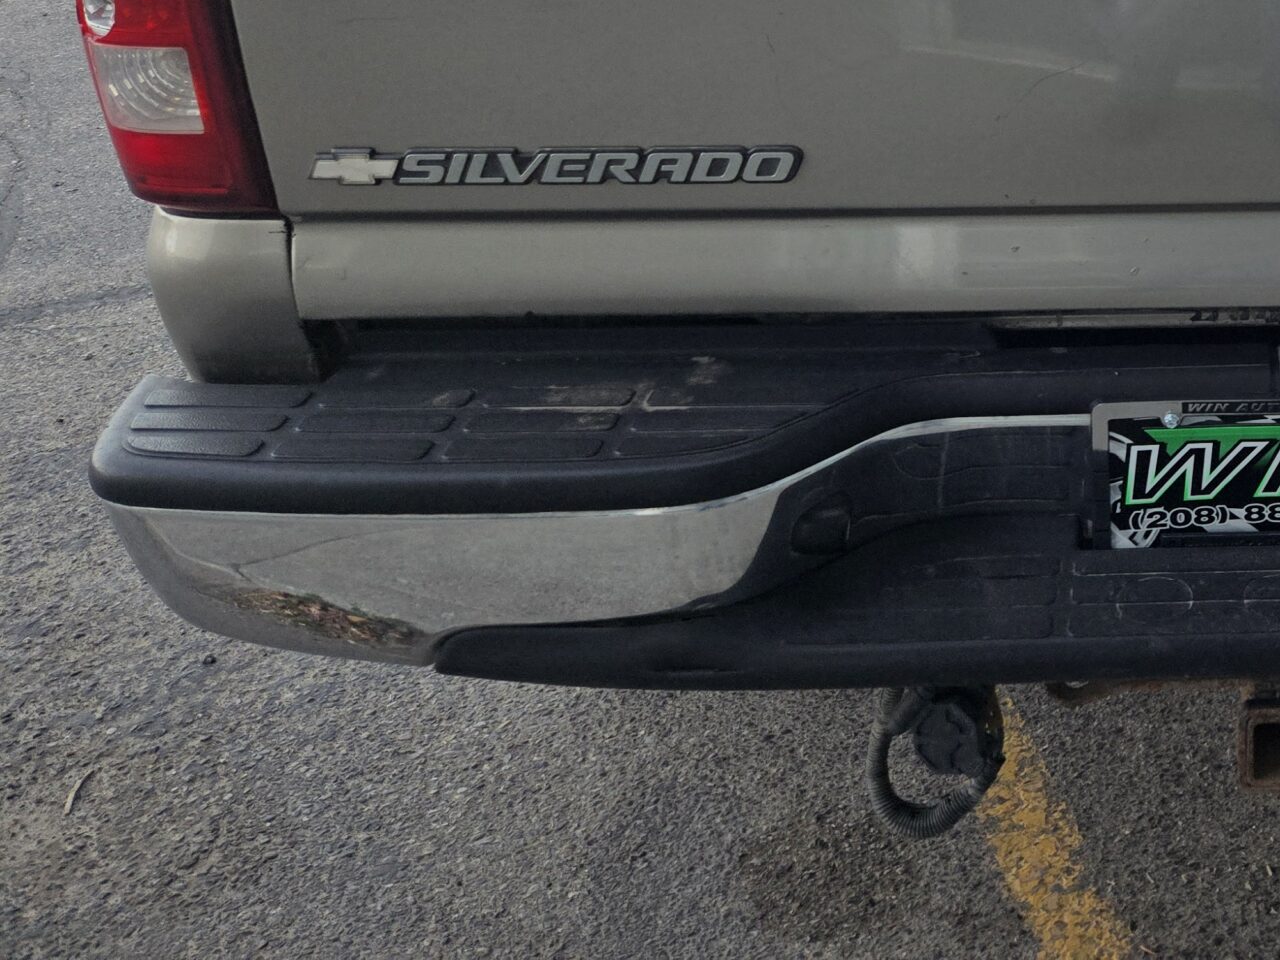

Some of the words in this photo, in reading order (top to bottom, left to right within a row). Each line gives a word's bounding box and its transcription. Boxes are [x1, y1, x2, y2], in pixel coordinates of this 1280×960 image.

[399, 148, 800, 184] SILVERADO
[1187, 401, 1231, 413] WIN
[1129, 506, 1230, 530] (208)
